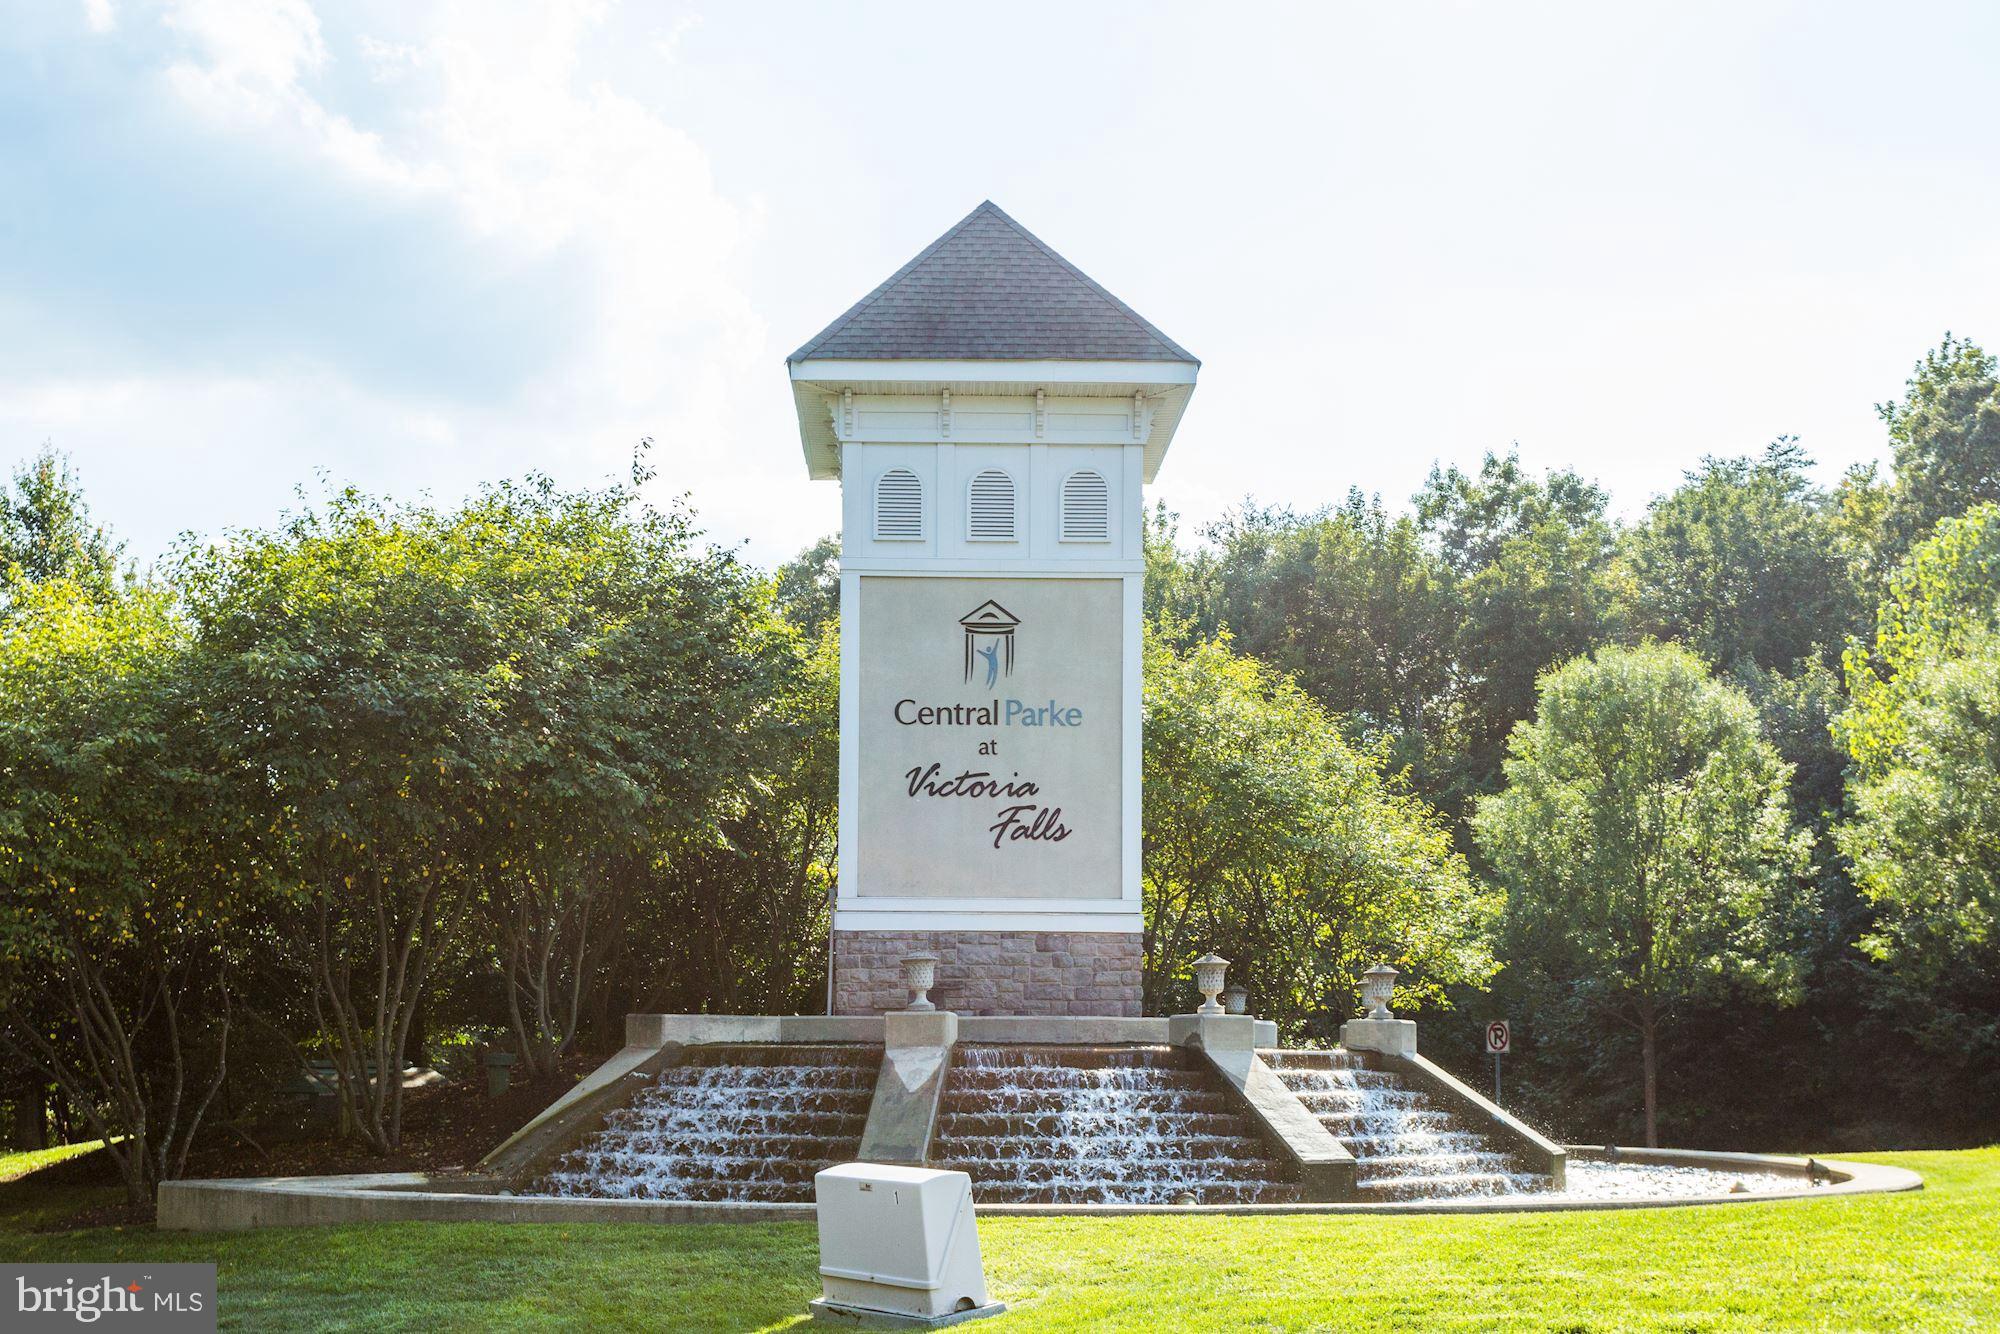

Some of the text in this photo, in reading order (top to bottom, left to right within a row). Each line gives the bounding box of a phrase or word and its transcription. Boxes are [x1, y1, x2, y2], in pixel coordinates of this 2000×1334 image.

[894, 699, 1082, 726] Central Parke
[978, 739, 998, 755] at
[905, 762, 1039, 798] Victoria
[989, 804, 1073, 849] Falls
